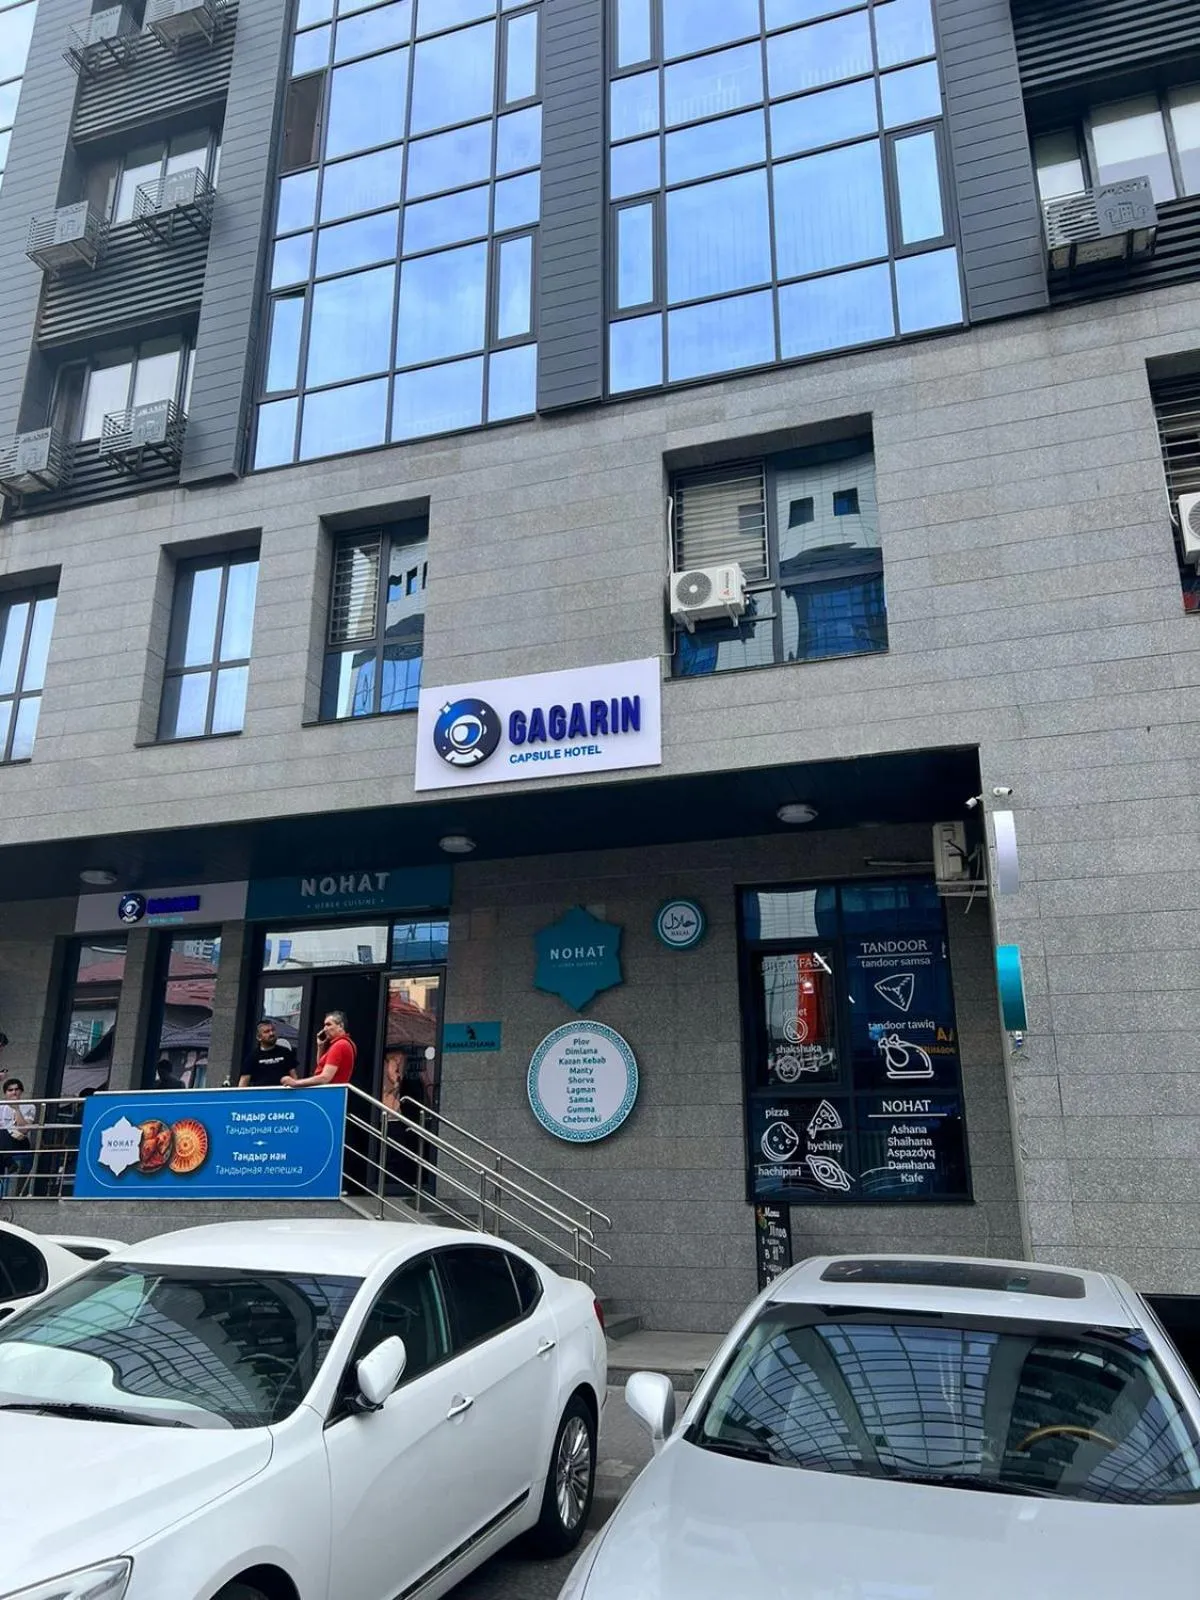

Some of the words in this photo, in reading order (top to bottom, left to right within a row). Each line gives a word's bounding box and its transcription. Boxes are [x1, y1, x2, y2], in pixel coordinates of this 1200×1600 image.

[508, 695, 641, 746] GAGARIN
[509, 749, 561, 764] CAPSULE
[564, 745, 602, 757] HOTEL
[301, 872, 390, 897] NOHAT
[860, 939, 928, 954] TANDOOR
[550, 945, 605, 960] NOHAT
[861, 958, 899, 968] tandoor
[901, 957, 931, 966] samsa
[868, 1020, 906, 1030] tandoor
[573, 1038, 590, 1046] Plov
[565, 1048, 598, 1056] Dimlama
[582, 1057, 606, 1065] Kebab
[569, 1067, 594, 1075] Manty
[566, 1086, 596, 1095] Lagman
[882, 1100, 931, 1113] NOHAT
[231, 1112, 266, 1123] Тандыр
[268, 1112, 295, 1121] самса
[765, 1108, 790, 1119] pizza
[225, 1125, 272, 1136] Тандырная
[273, 1125, 299, 1134] самса
[891, 1125, 927, 1134] Ashana
[107, 1140, 134, 1148] NOHAT
[888, 1137, 932, 1146] Shaihana
[232, 1152, 269, 1163] Тандыр
[270, 1152, 286, 1161] нан
[215, 1165, 262, 1176] Тандырная
[263, 1165, 303, 1175] лепешка
[901, 1173, 924, 1183] Kafe
